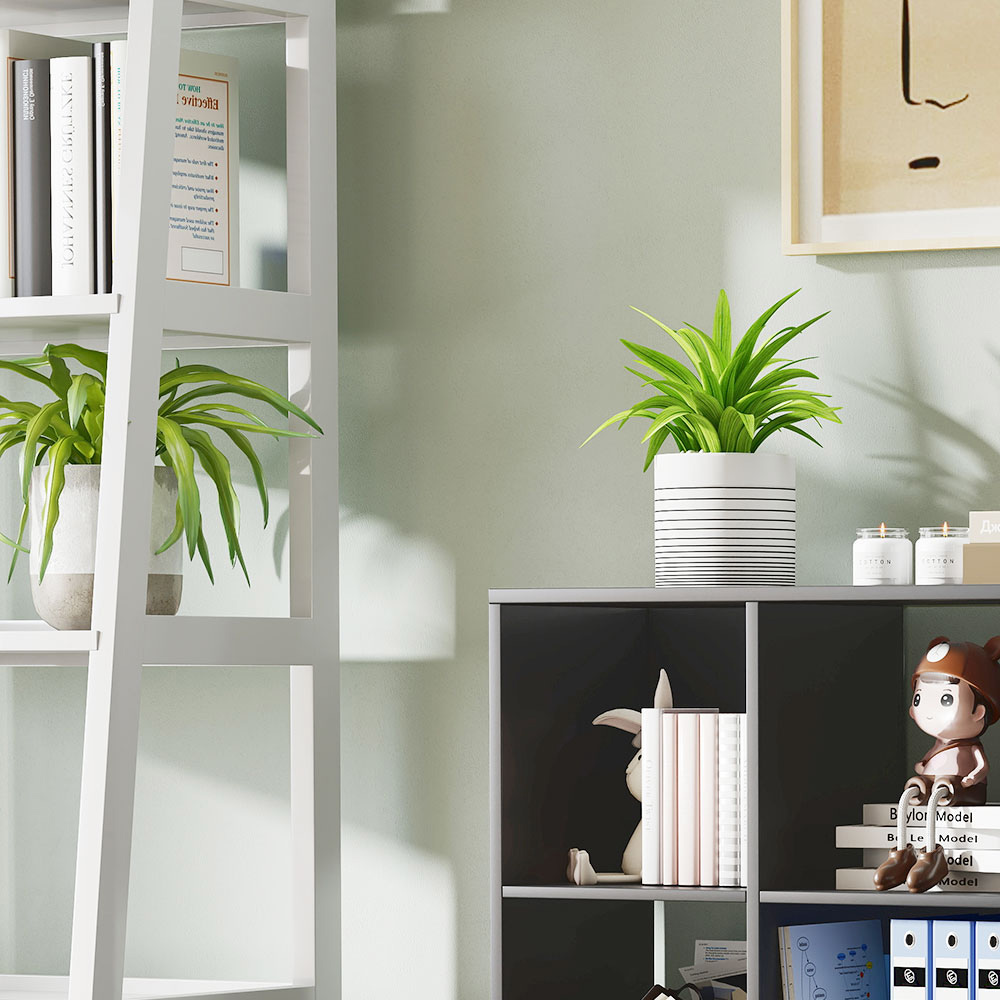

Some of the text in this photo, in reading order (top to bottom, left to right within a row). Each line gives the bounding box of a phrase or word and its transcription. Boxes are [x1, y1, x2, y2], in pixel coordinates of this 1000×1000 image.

[936, 810, 973, 823] Model
[939, 834, 978, 843] Model
[947, 855, 973, 866] odel
